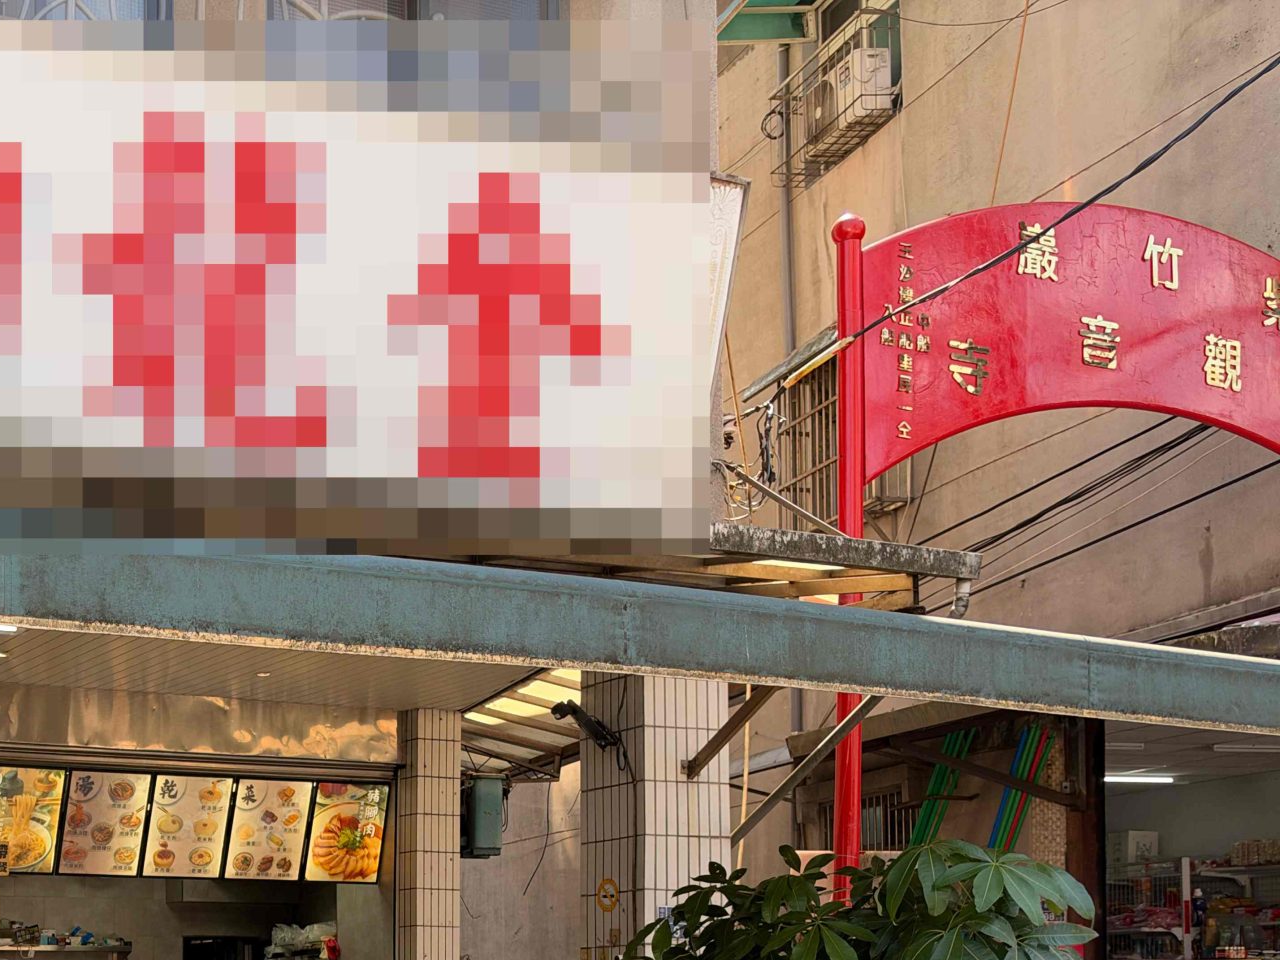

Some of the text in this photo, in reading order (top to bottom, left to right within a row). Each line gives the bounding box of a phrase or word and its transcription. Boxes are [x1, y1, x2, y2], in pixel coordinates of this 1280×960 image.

[73, 774, 95, 797] 湯
[160, 778, 178, 799] 乾
[241, 784, 257, 806] 菜
